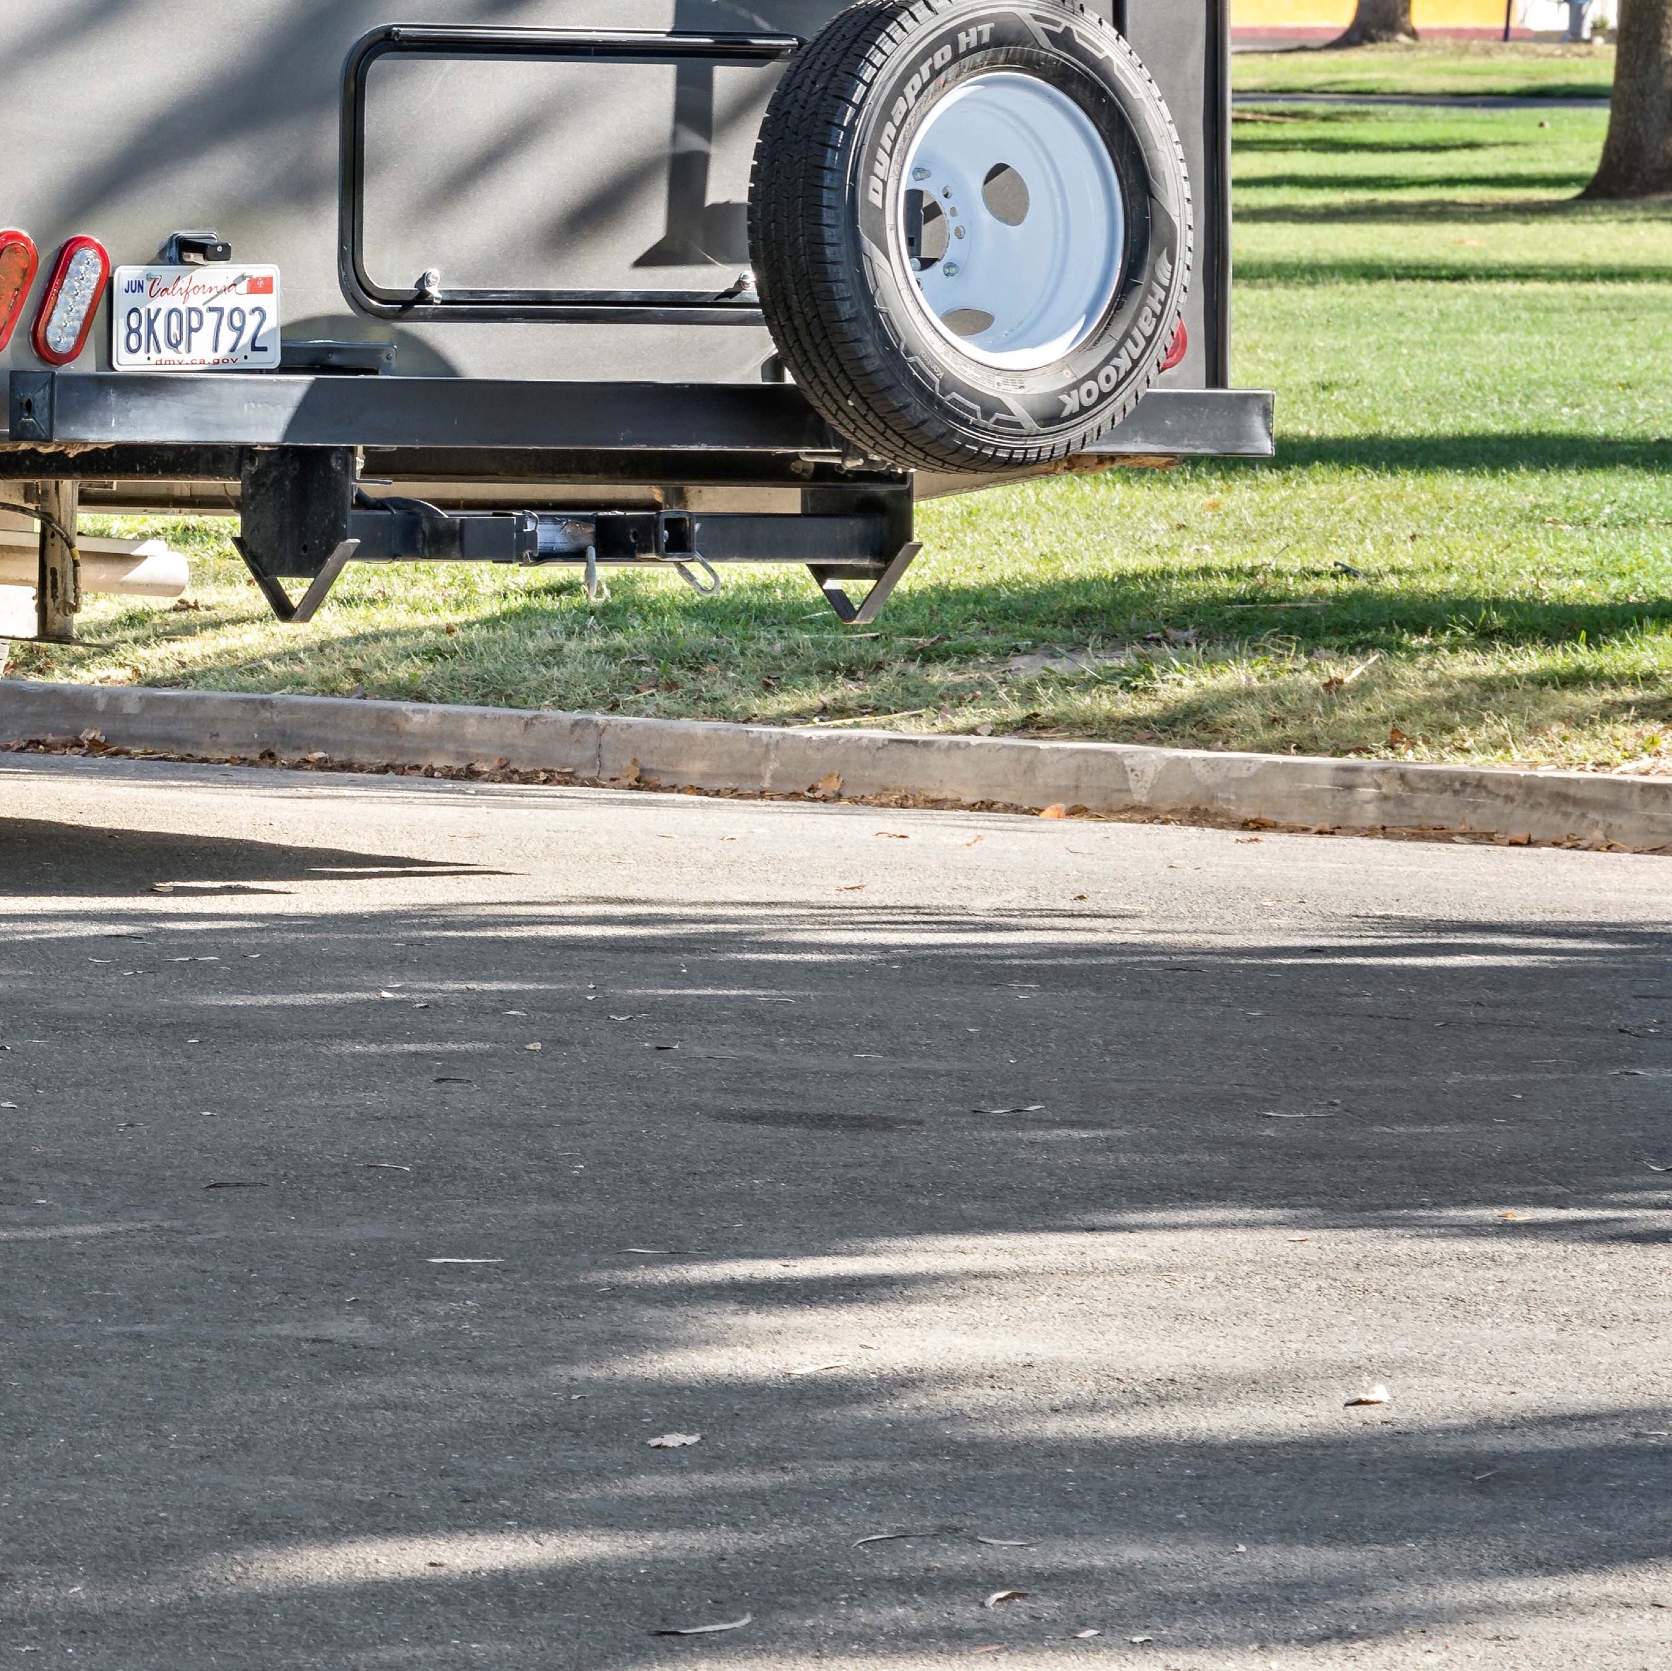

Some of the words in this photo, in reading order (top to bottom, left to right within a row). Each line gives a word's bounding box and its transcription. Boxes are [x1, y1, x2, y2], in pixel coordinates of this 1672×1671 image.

[868, 44, 952, 209] Dynapro
[958, 23, 995, 54] HT
[124, 279, 145, 294] JUN
[148, 274, 239, 305] California
[125, 306, 269, 354] 8KQP792
[155, 356, 239, 366] dmv.ca.gov
